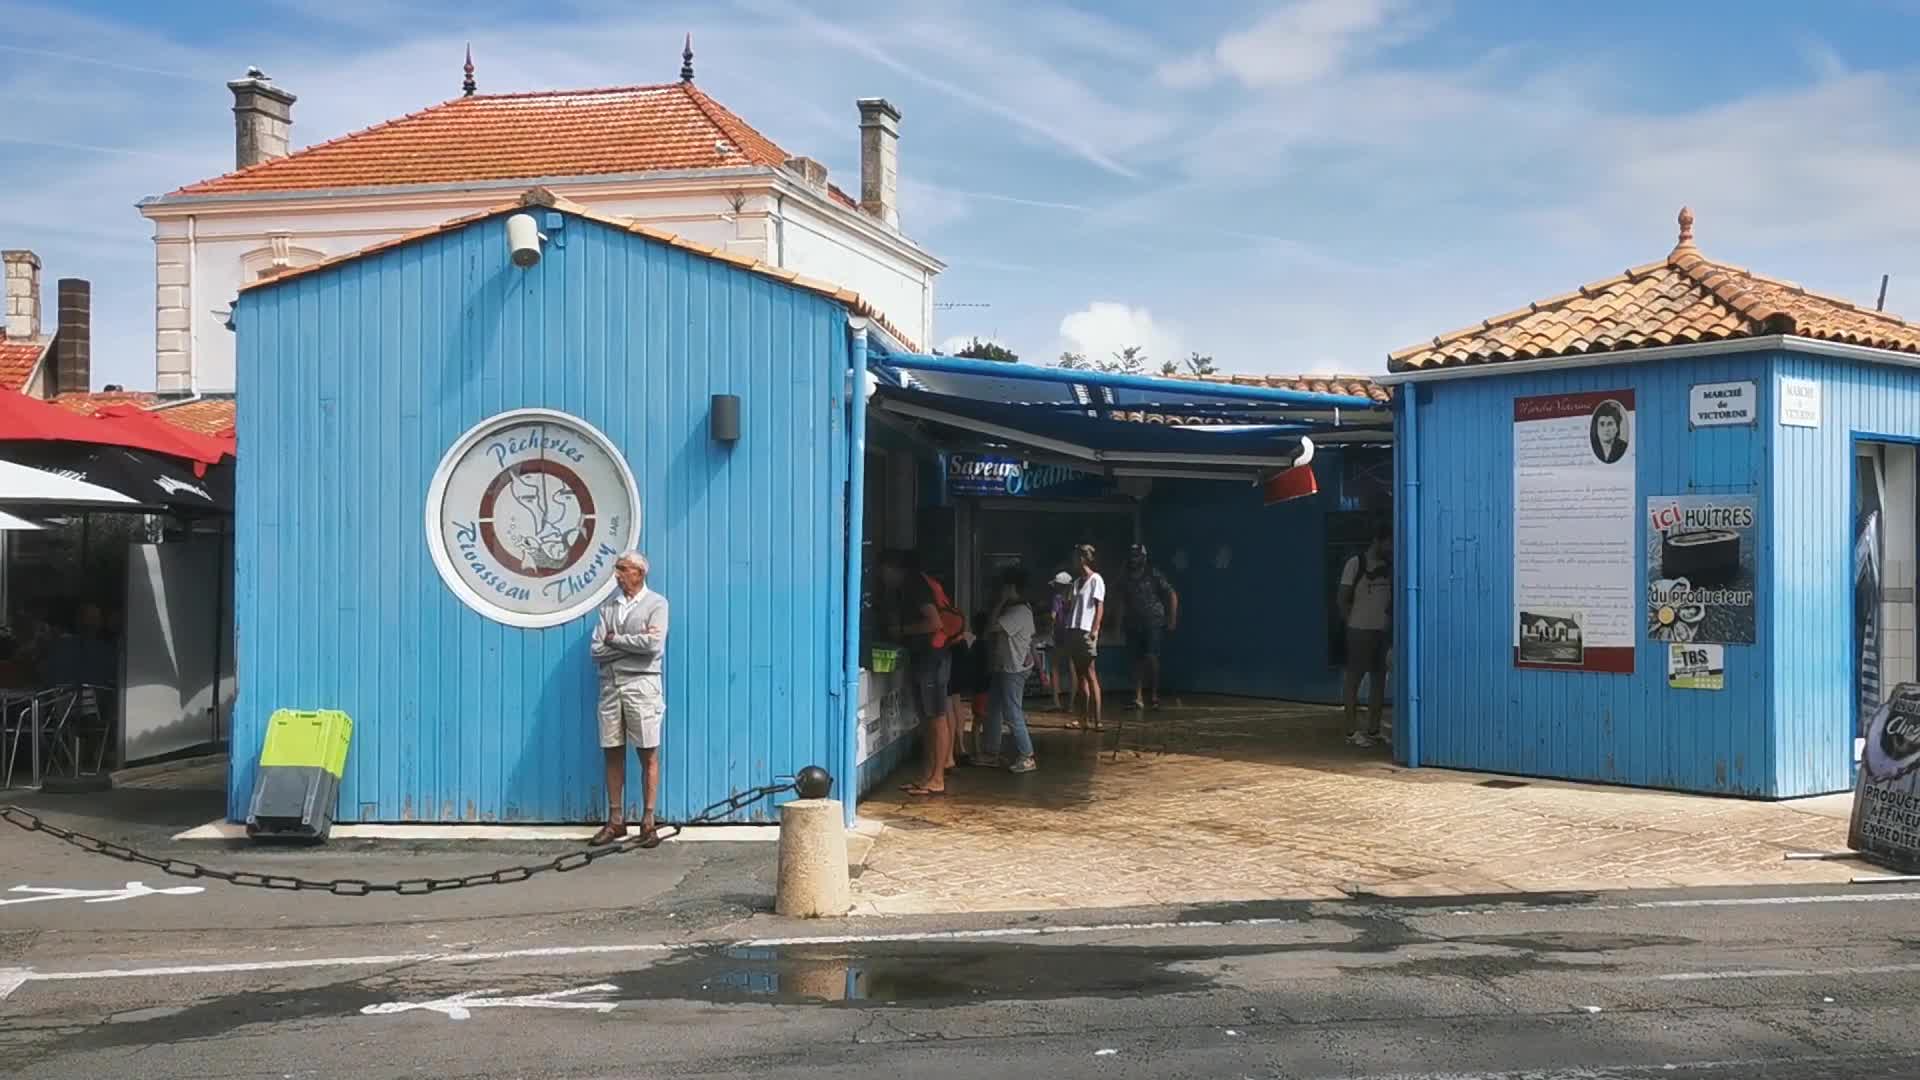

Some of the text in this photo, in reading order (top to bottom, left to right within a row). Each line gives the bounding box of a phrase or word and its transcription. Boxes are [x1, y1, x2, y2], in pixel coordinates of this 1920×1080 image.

[1703, 388, 1742, 399] MARCHÉ
[1698, 410, 1748, 420] VICTORINE
[486, 429, 584, 468] Pêcheries
[1685, 504, 1752, 527] HUÎTRES
[452, 520, 530, 600] Rivasseau
[543, 543, 617, 603] Thierry
[1652, 587, 1751, 605] du producteur
[1680, 649, 1709, 667] TBS
[1865, 785, 1920, 810] PRODUCT
